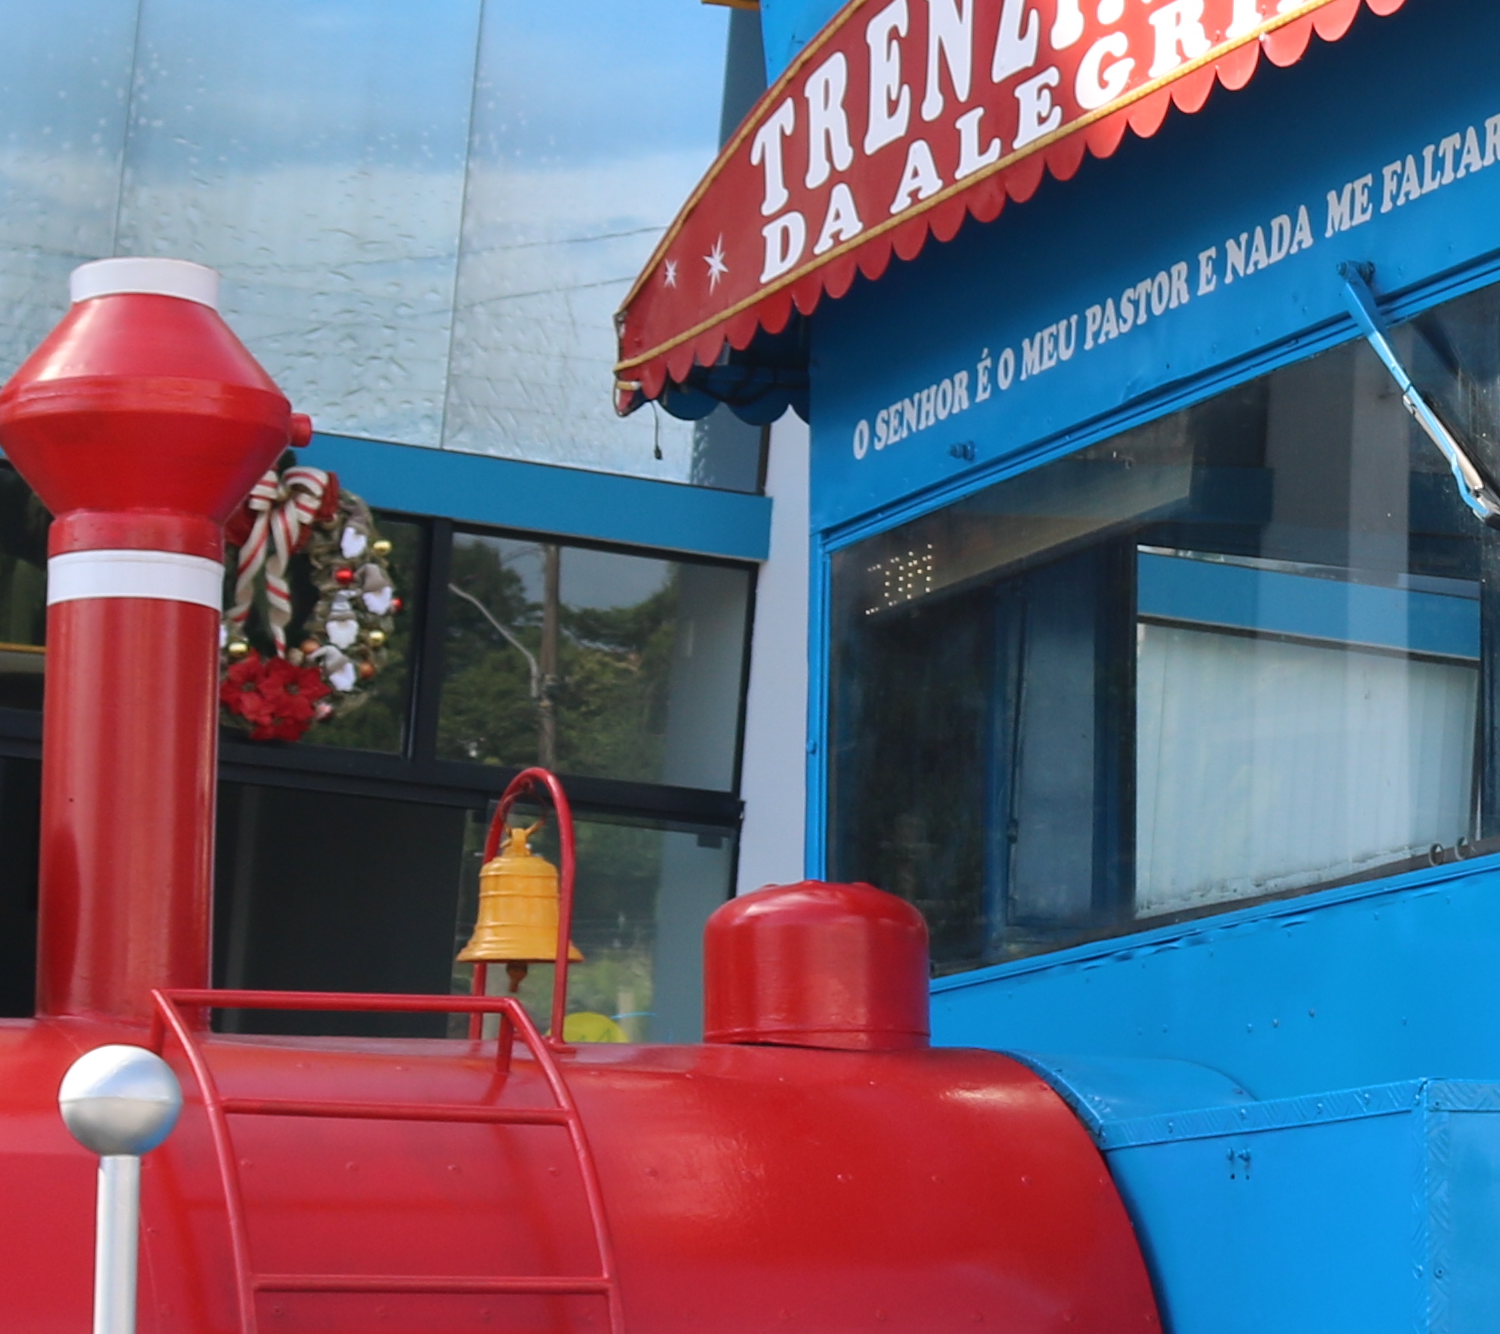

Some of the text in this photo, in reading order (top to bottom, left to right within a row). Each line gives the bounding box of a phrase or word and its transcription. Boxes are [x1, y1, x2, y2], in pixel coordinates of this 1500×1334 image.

[761, 193, 862, 284] DA
[853, 420, 869, 459] O
[873, 367, 969, 449] SENHOR
[976, 348, 993, 389] É
[998, 346, 1014, 384] O
[1019, 304, 1077, 373] MEU
[1084, 262, 1188, 350] PASTOR
[1197, 244, 1217, 292] E
[1225, 201, 1313, 281] NADA
[1326, 172, 1373, 236] ME
